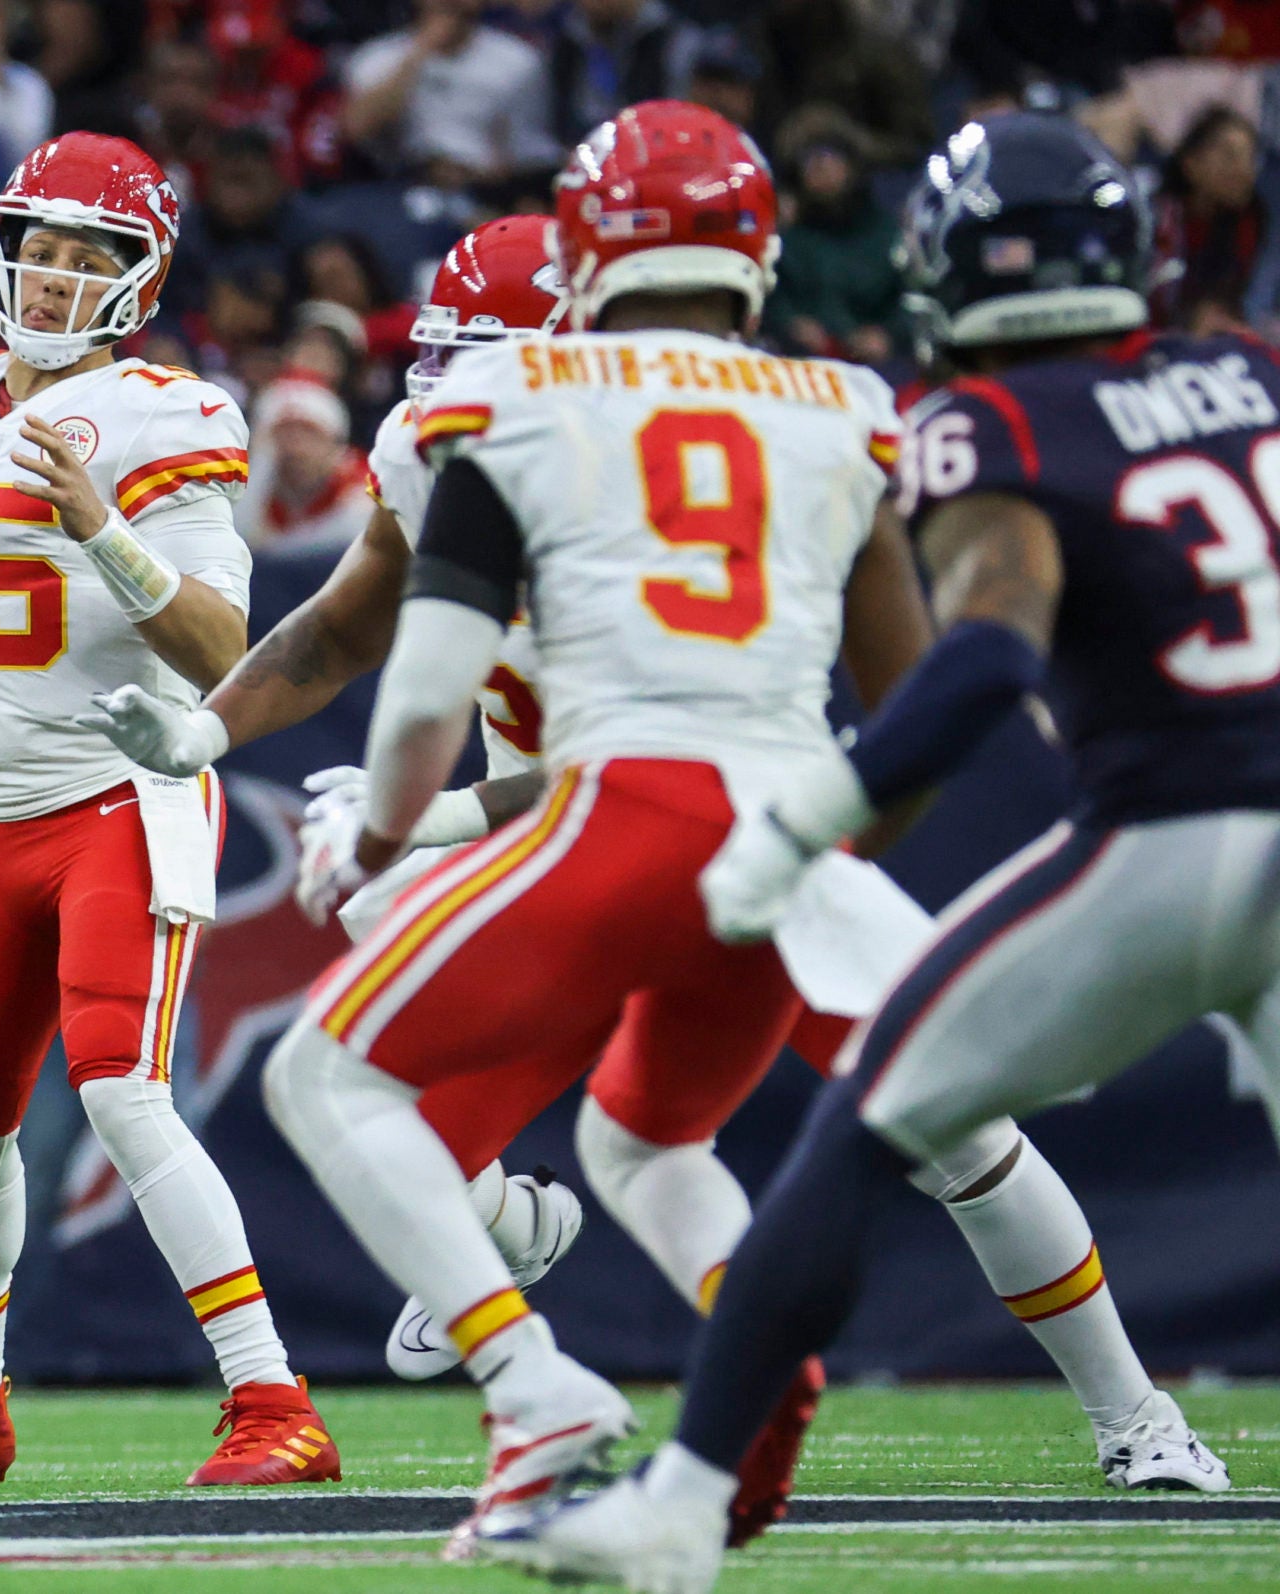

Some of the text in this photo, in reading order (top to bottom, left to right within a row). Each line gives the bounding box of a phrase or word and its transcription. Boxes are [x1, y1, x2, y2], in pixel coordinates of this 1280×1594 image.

[1094, 353, 1278, 453] OWENS
[636, 407, 770, 647] 9
[1114, 432, 1280, 695] 3
